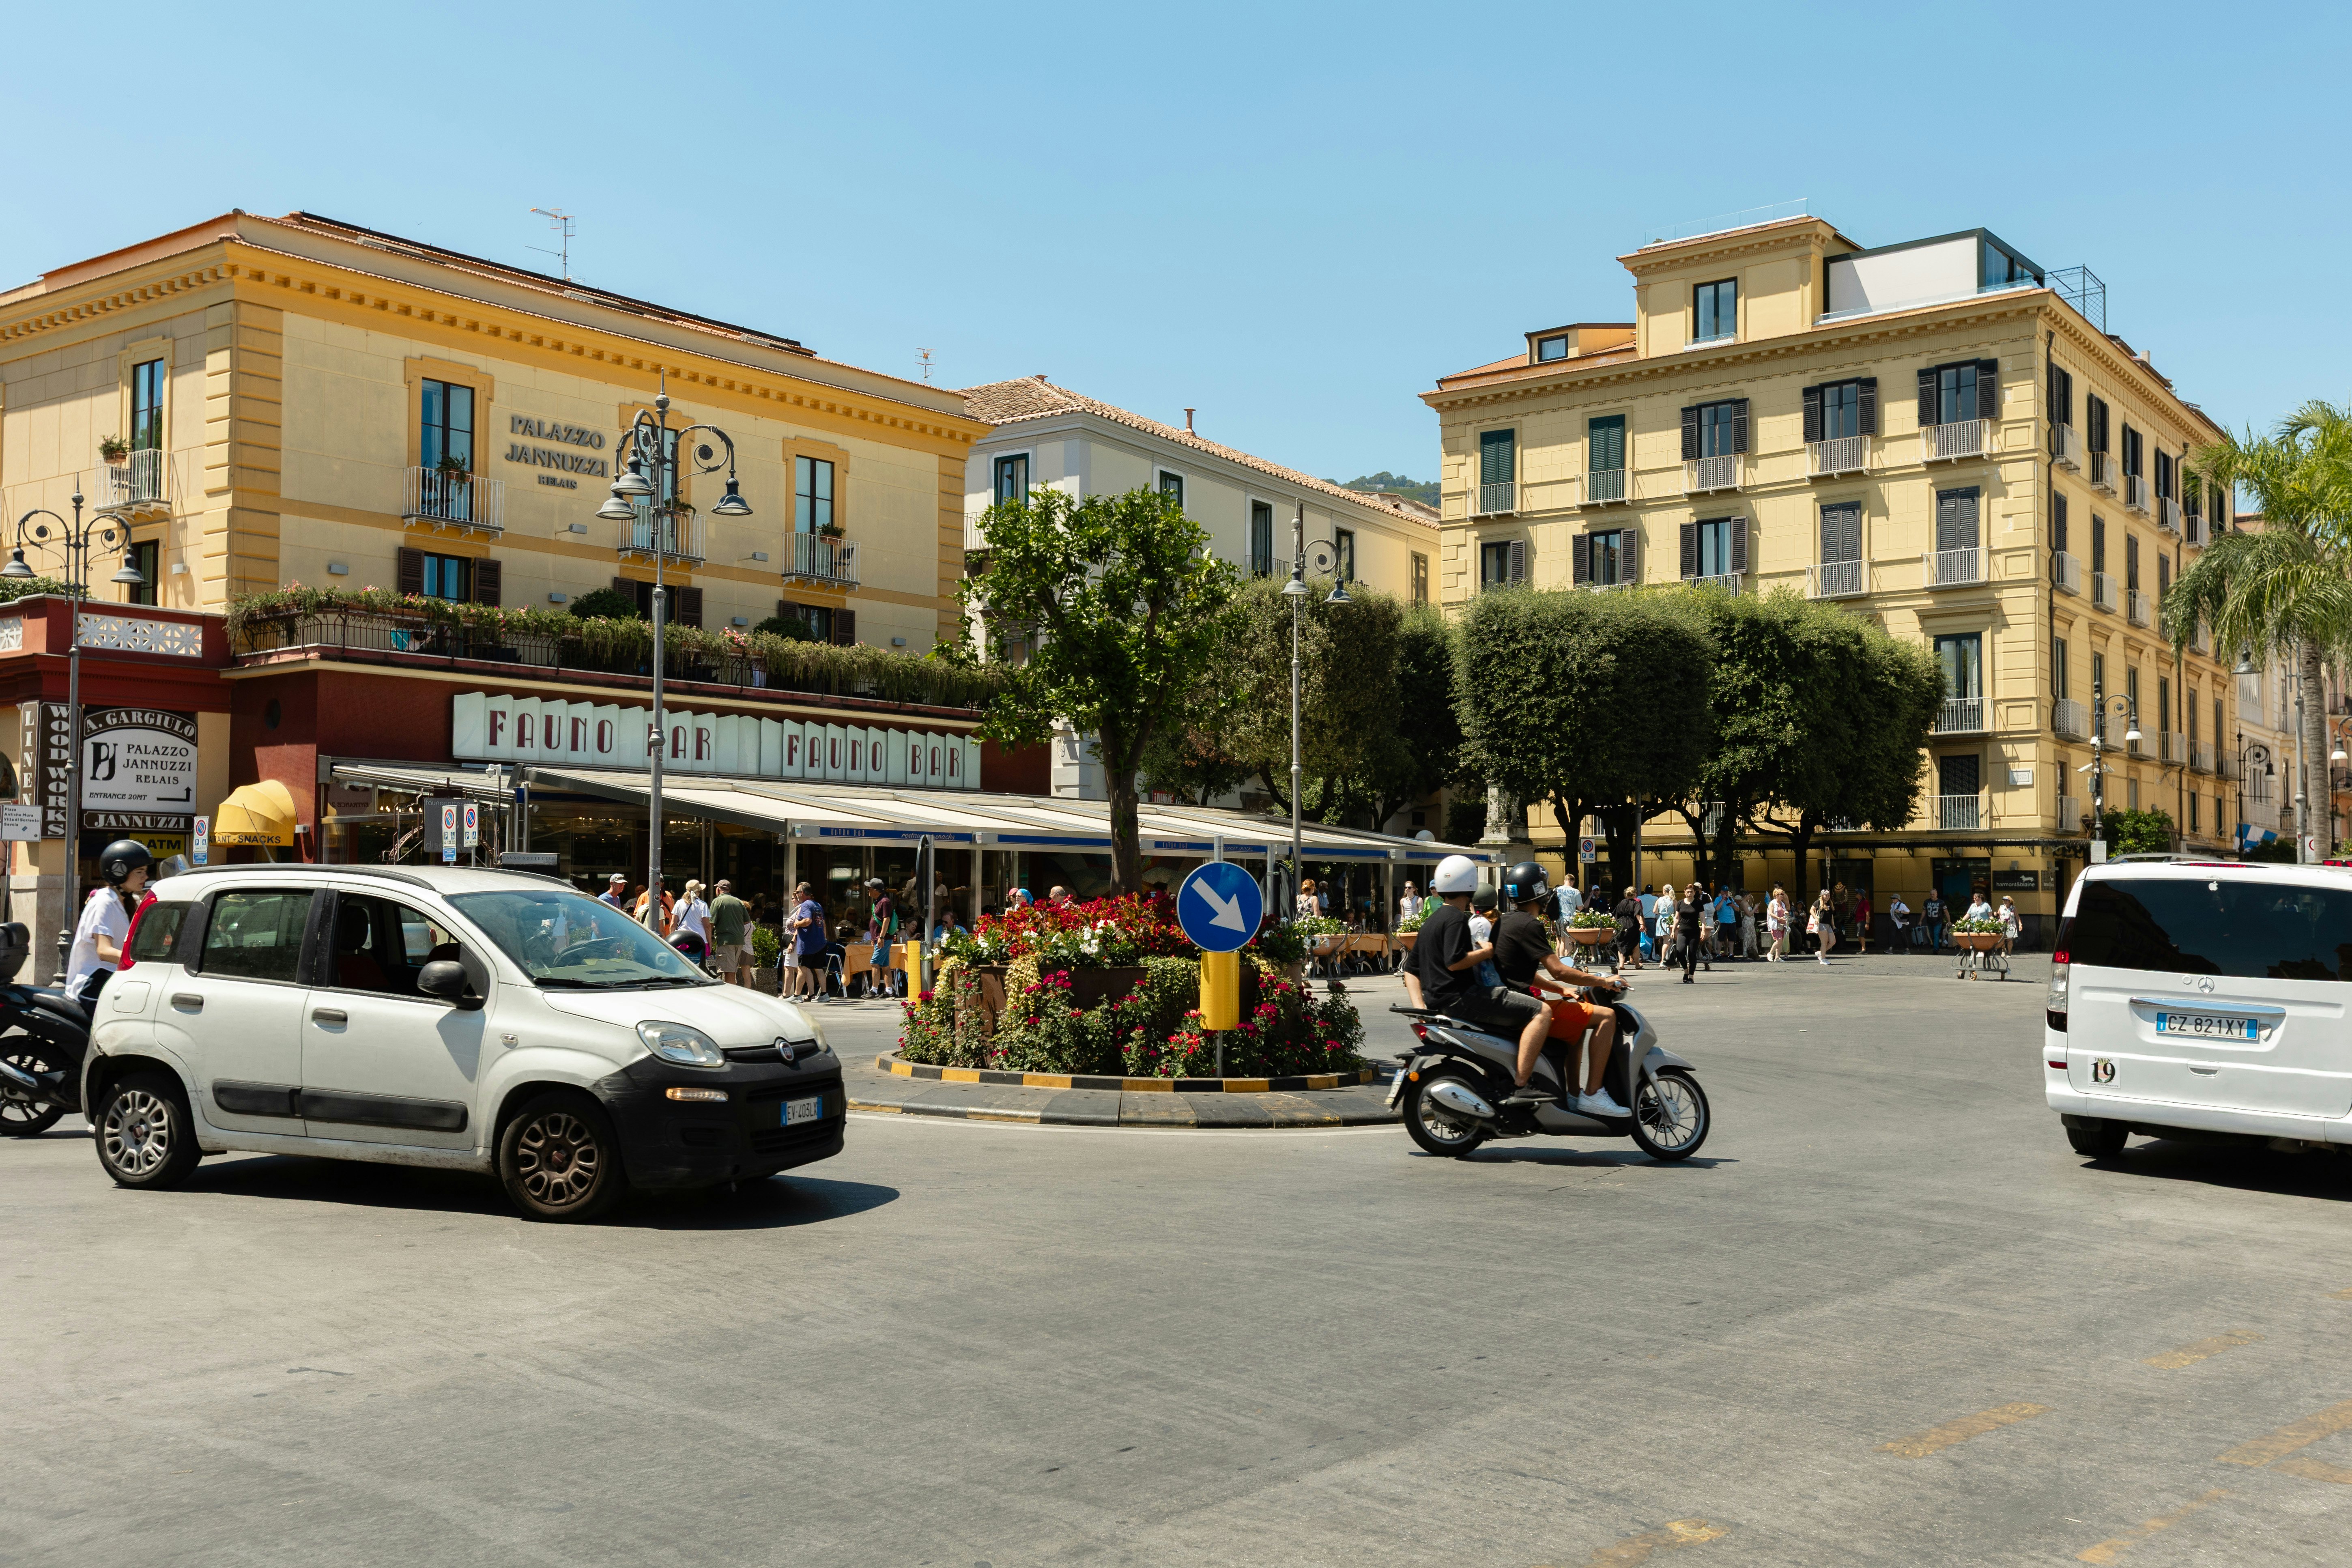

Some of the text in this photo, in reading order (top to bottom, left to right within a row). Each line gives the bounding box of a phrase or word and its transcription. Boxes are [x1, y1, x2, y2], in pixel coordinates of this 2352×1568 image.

[511, 415, 606, 450] PALAZZO
[505, 445, 609, 478] JANNUZZI
[538, 475, 578, 490] RELAIS
[86, 711, 195, 737] A. GARGIULO
[489, 710, 711, 761] FAUNO AR
[127, 744, 189, 757] PALAZZO
[787, 734, 960, 777] FAUNO BAR
[123, 759, 191, 772] JANNUZZI
[135, 774, 179, 785] RELAIS
[94, 814, 186, 829] JANNUZZI
[146, 839, 181, 850] ATM
[238, 835, 282, 844] SNACKS
[1927, 906, 1939, 917] 82
[2168, 1015, 2187, 1031] CZ
[2194, 1017, 2246, 1036] 821XY
[2091, 1062, 2116, 1084] 19
[787, 1105, 795, 1121] EV
